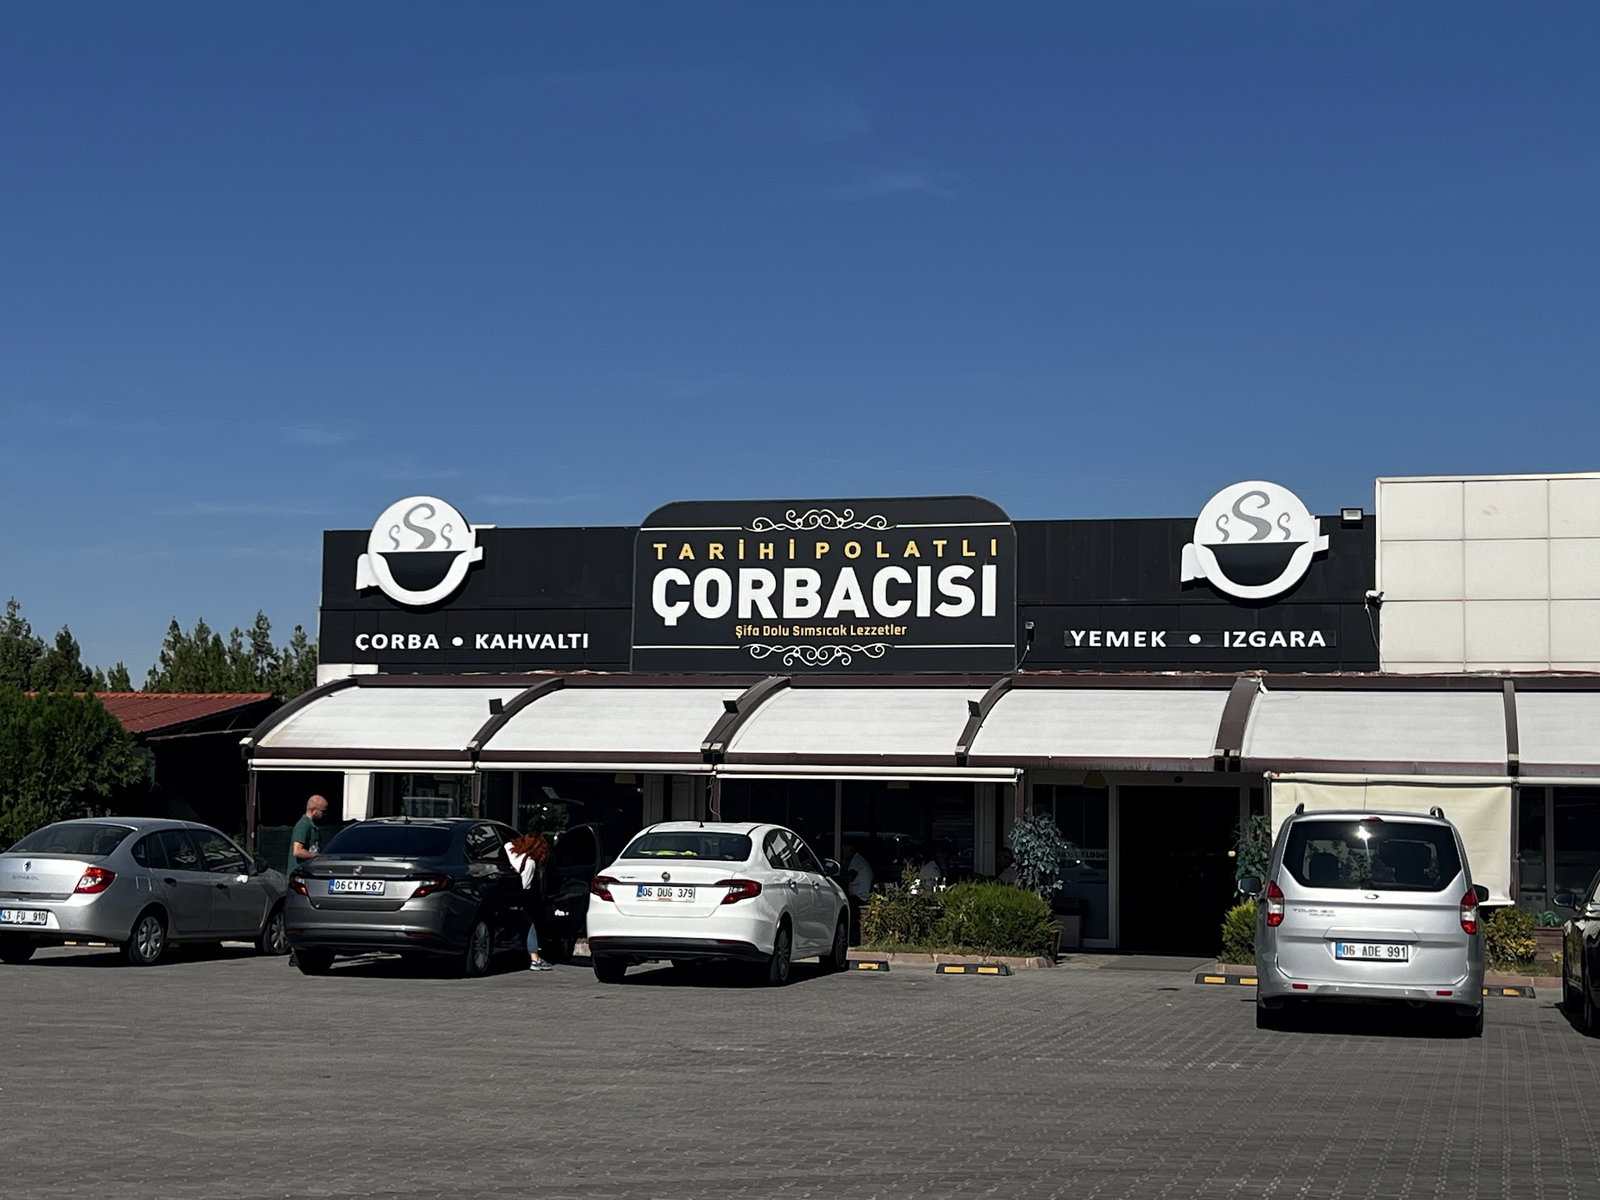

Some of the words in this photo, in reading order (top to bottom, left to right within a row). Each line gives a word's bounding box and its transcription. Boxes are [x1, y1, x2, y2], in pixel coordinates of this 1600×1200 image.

[653, 538, 796, 560] TARİHİ
[815, 538, 997, 559] POLATLI
[652, 564, 997, 626] ÇORBACISI
[735, 625, 760, 639] Şifa
[762, 625, 790, 637] Dolu
[792, 625, 848, 637] Sımsıcak
[850, 624, 907, 637] Lezzetler
[1070, 630, 1167, 648] YEMEK
[1223, 630, 1326, 648] IZGARA
[355, 633, 440, 650] ÇORBA
[475, 633, 589, 649] KAHVALTI
[335, 880, 346, 890] 06
[366, 881, 384, 891] 567
[642, 887, 653, 897] 06
[677, 888, 694, 898] 379
[32, 911, 46, 921] 910
[1342, 944, 1356, 956] 06
[1362, 945, 1382, 957] ADE
[1387, 946, 1406, 958] 991
